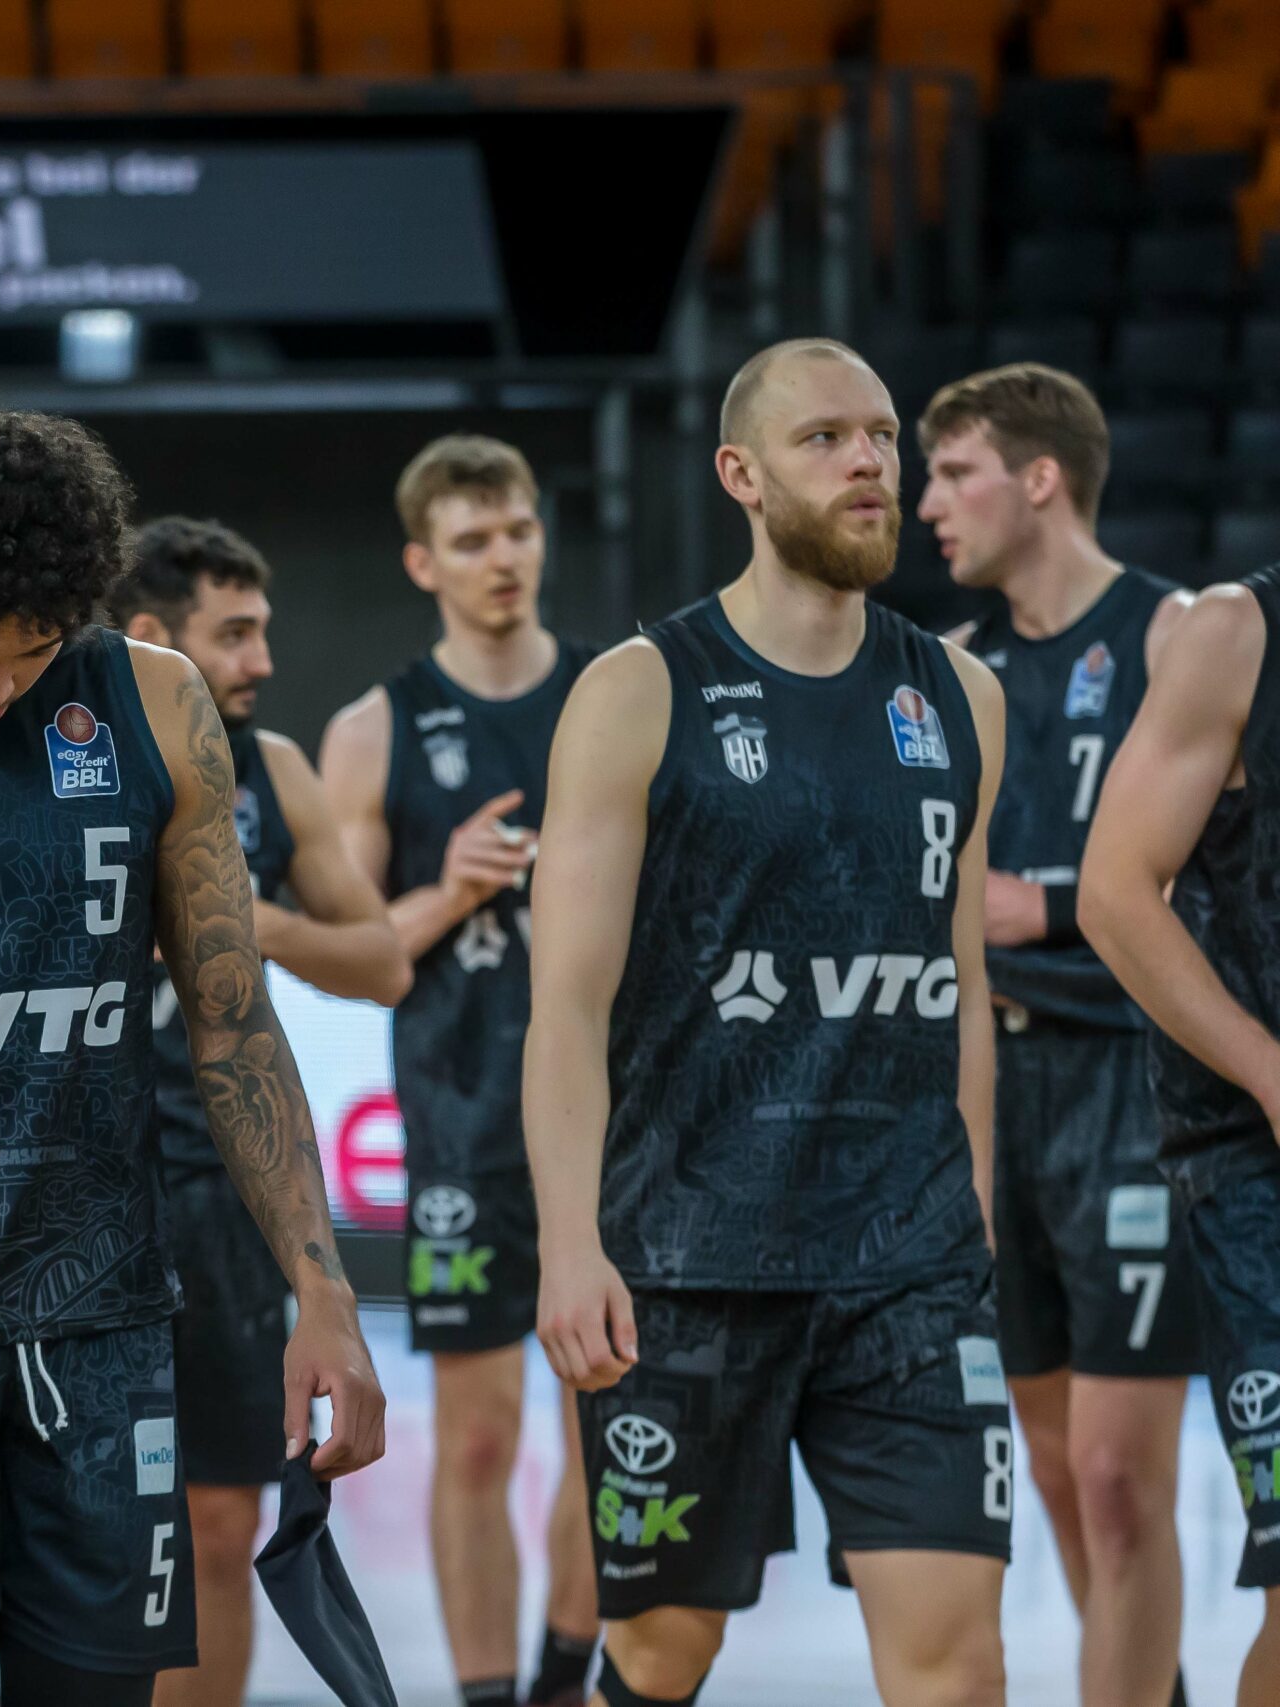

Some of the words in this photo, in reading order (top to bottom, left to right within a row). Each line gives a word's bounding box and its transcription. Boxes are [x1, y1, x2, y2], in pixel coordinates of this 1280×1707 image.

[62, 768, 111, 789] BBL
[1069, 734, 1105, 822] 7
[83, 826, 130, 935] 5
[920, 798, 956, 899] 8
[810, 953, 958, 1019] VTG
[1119, 1261, 1167, 1350] 7
[594, 1486, 702, 1548] S+K
[982, 1425, 1013, 1523] 8
[143, 1522, 174, 1627] 5
